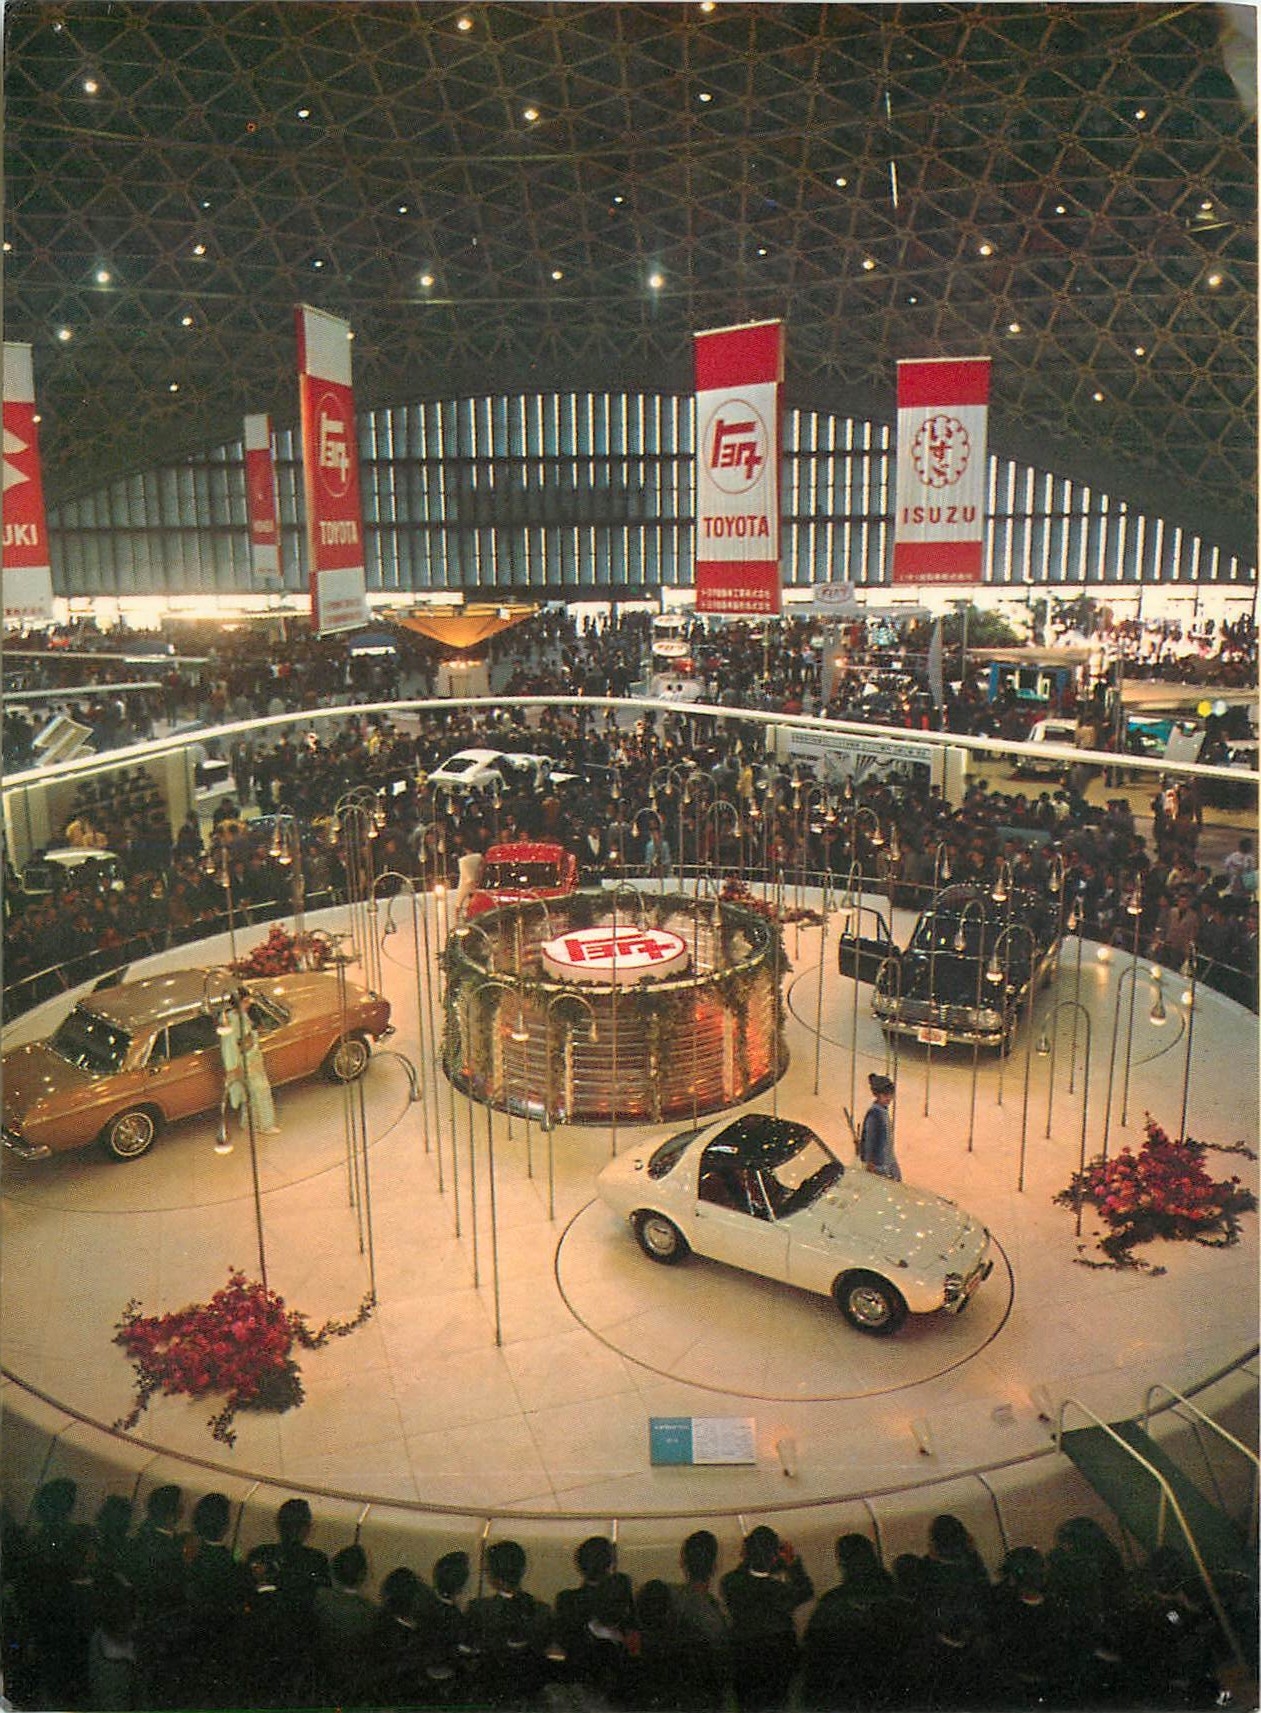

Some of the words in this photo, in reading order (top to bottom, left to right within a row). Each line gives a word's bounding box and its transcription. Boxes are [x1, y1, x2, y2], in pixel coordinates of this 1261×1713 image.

[903, 507, 975, 523] ISUZU
[319, 520, 358, 545] TOYOTA
[704, 516, 769, 538] TOYOTA
